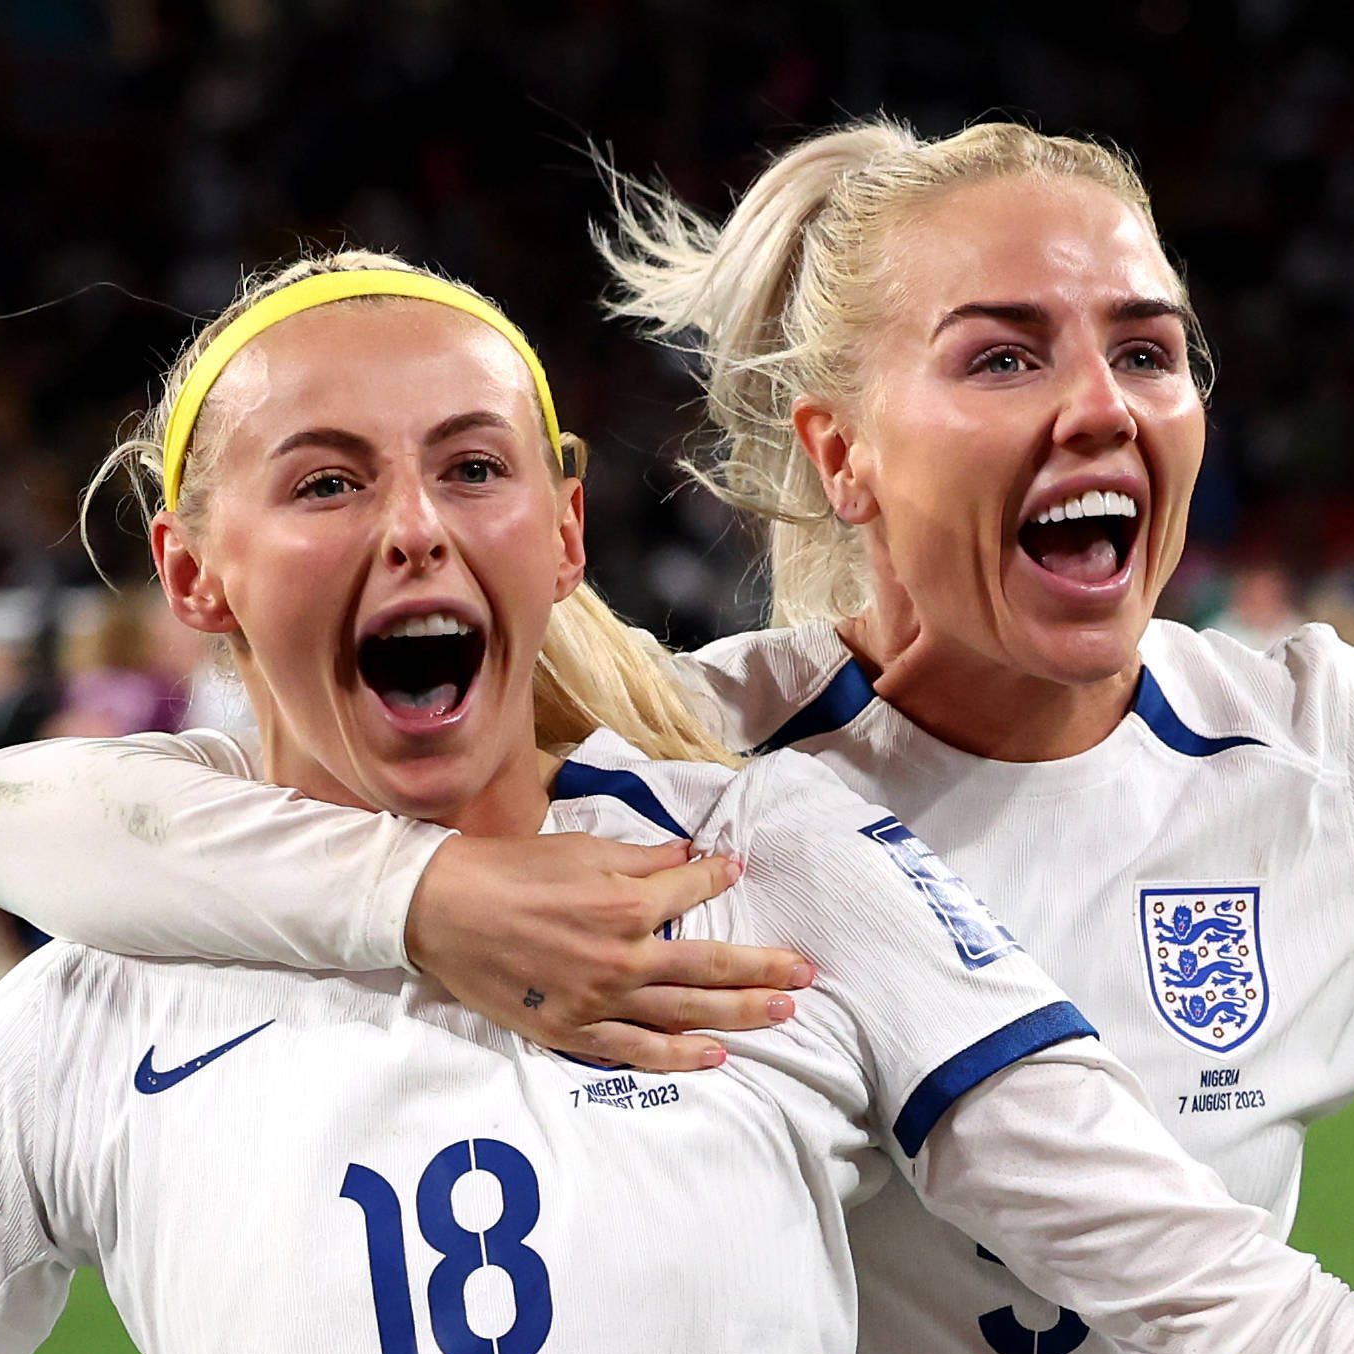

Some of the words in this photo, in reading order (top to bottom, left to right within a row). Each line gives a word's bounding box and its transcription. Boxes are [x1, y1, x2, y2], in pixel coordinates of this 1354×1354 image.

[582, 1074, 639, 1097] NIGERIA
[1200, 1068, 1240, 1088] NIGERIA
[569, 1089, 580, 1108] 7
[638, 1083, 680, 1109] 2023
[1178, 1096, 1188, 1115] 7
[1191, 1092, 1232, 1113] AUGUST
[1234, 1089, 1266, 1110] 2023
